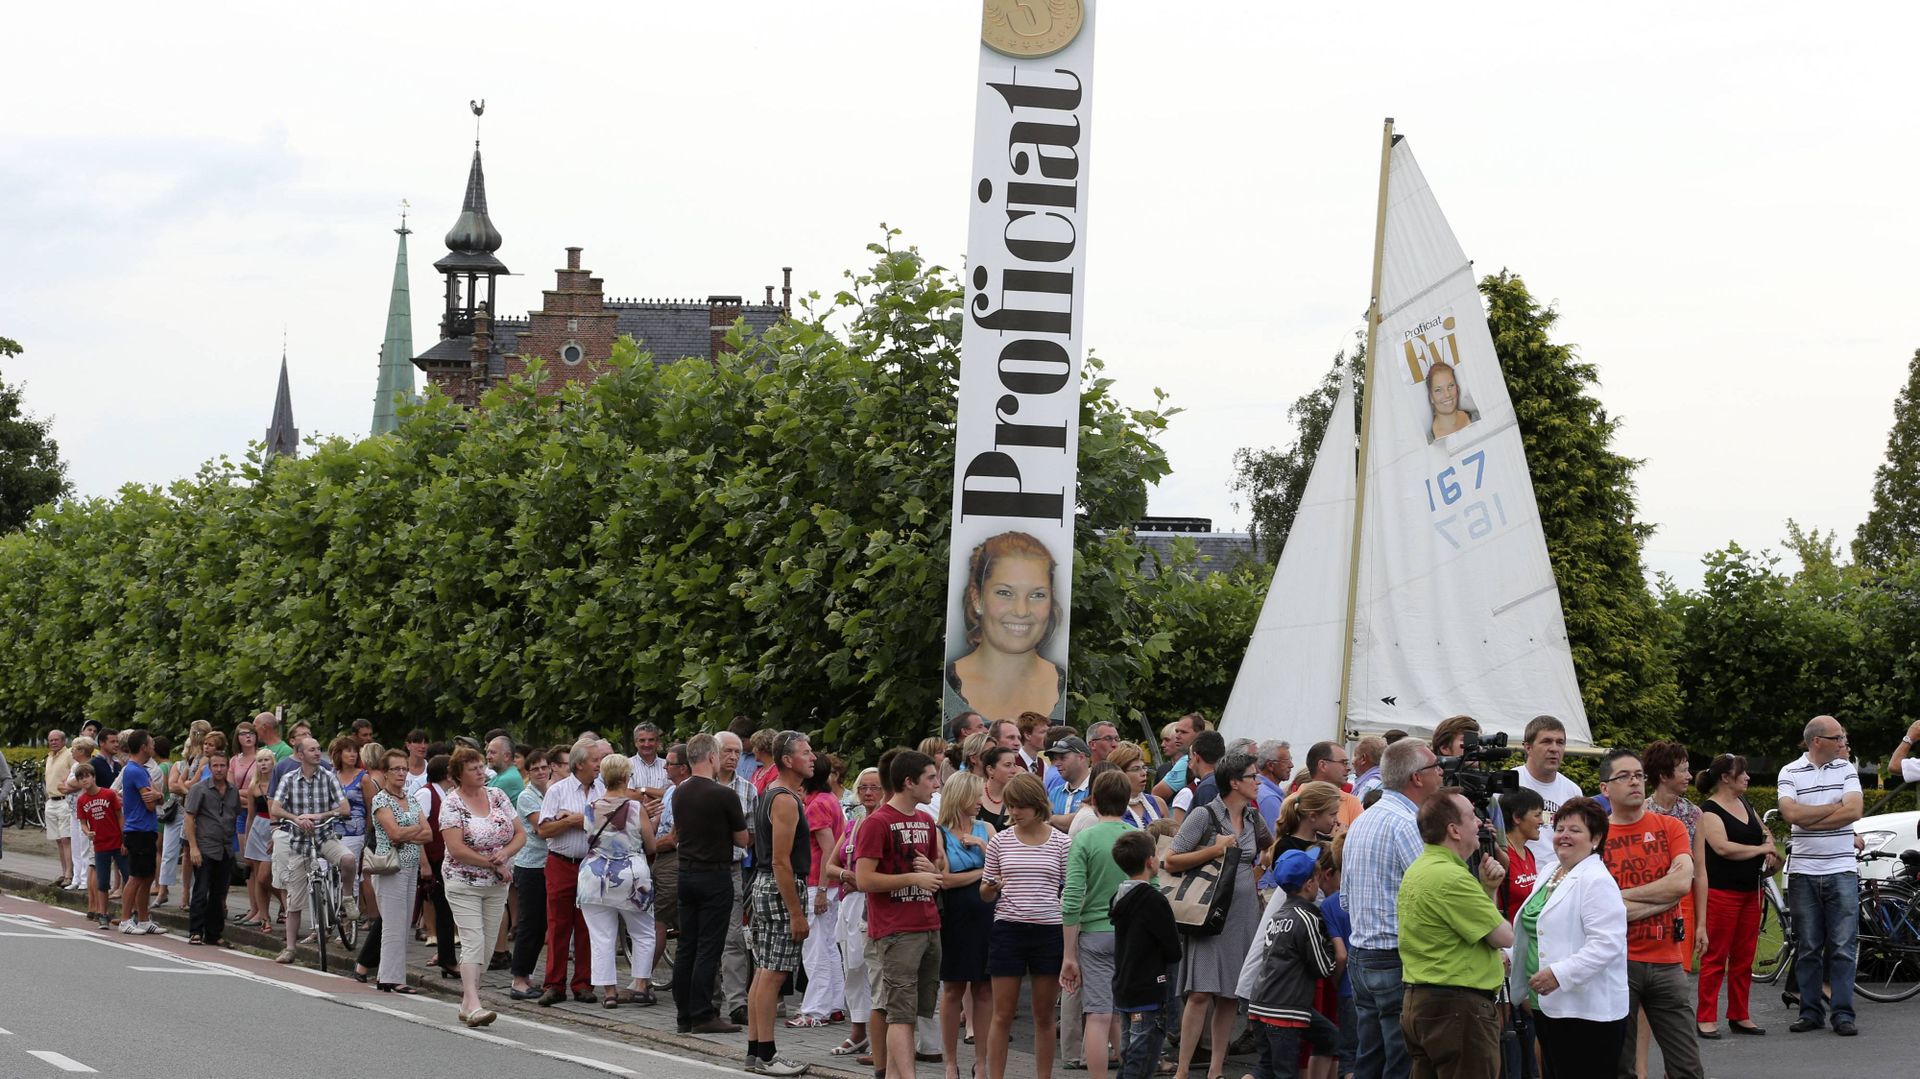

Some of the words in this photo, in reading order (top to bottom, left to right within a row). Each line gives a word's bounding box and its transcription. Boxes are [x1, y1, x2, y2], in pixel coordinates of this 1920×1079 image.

[961, 65, 1082, 527] Proficiat
[1404, 315, 1442, 340] Proficiat
[1425, 450, 1486, 512] 167
